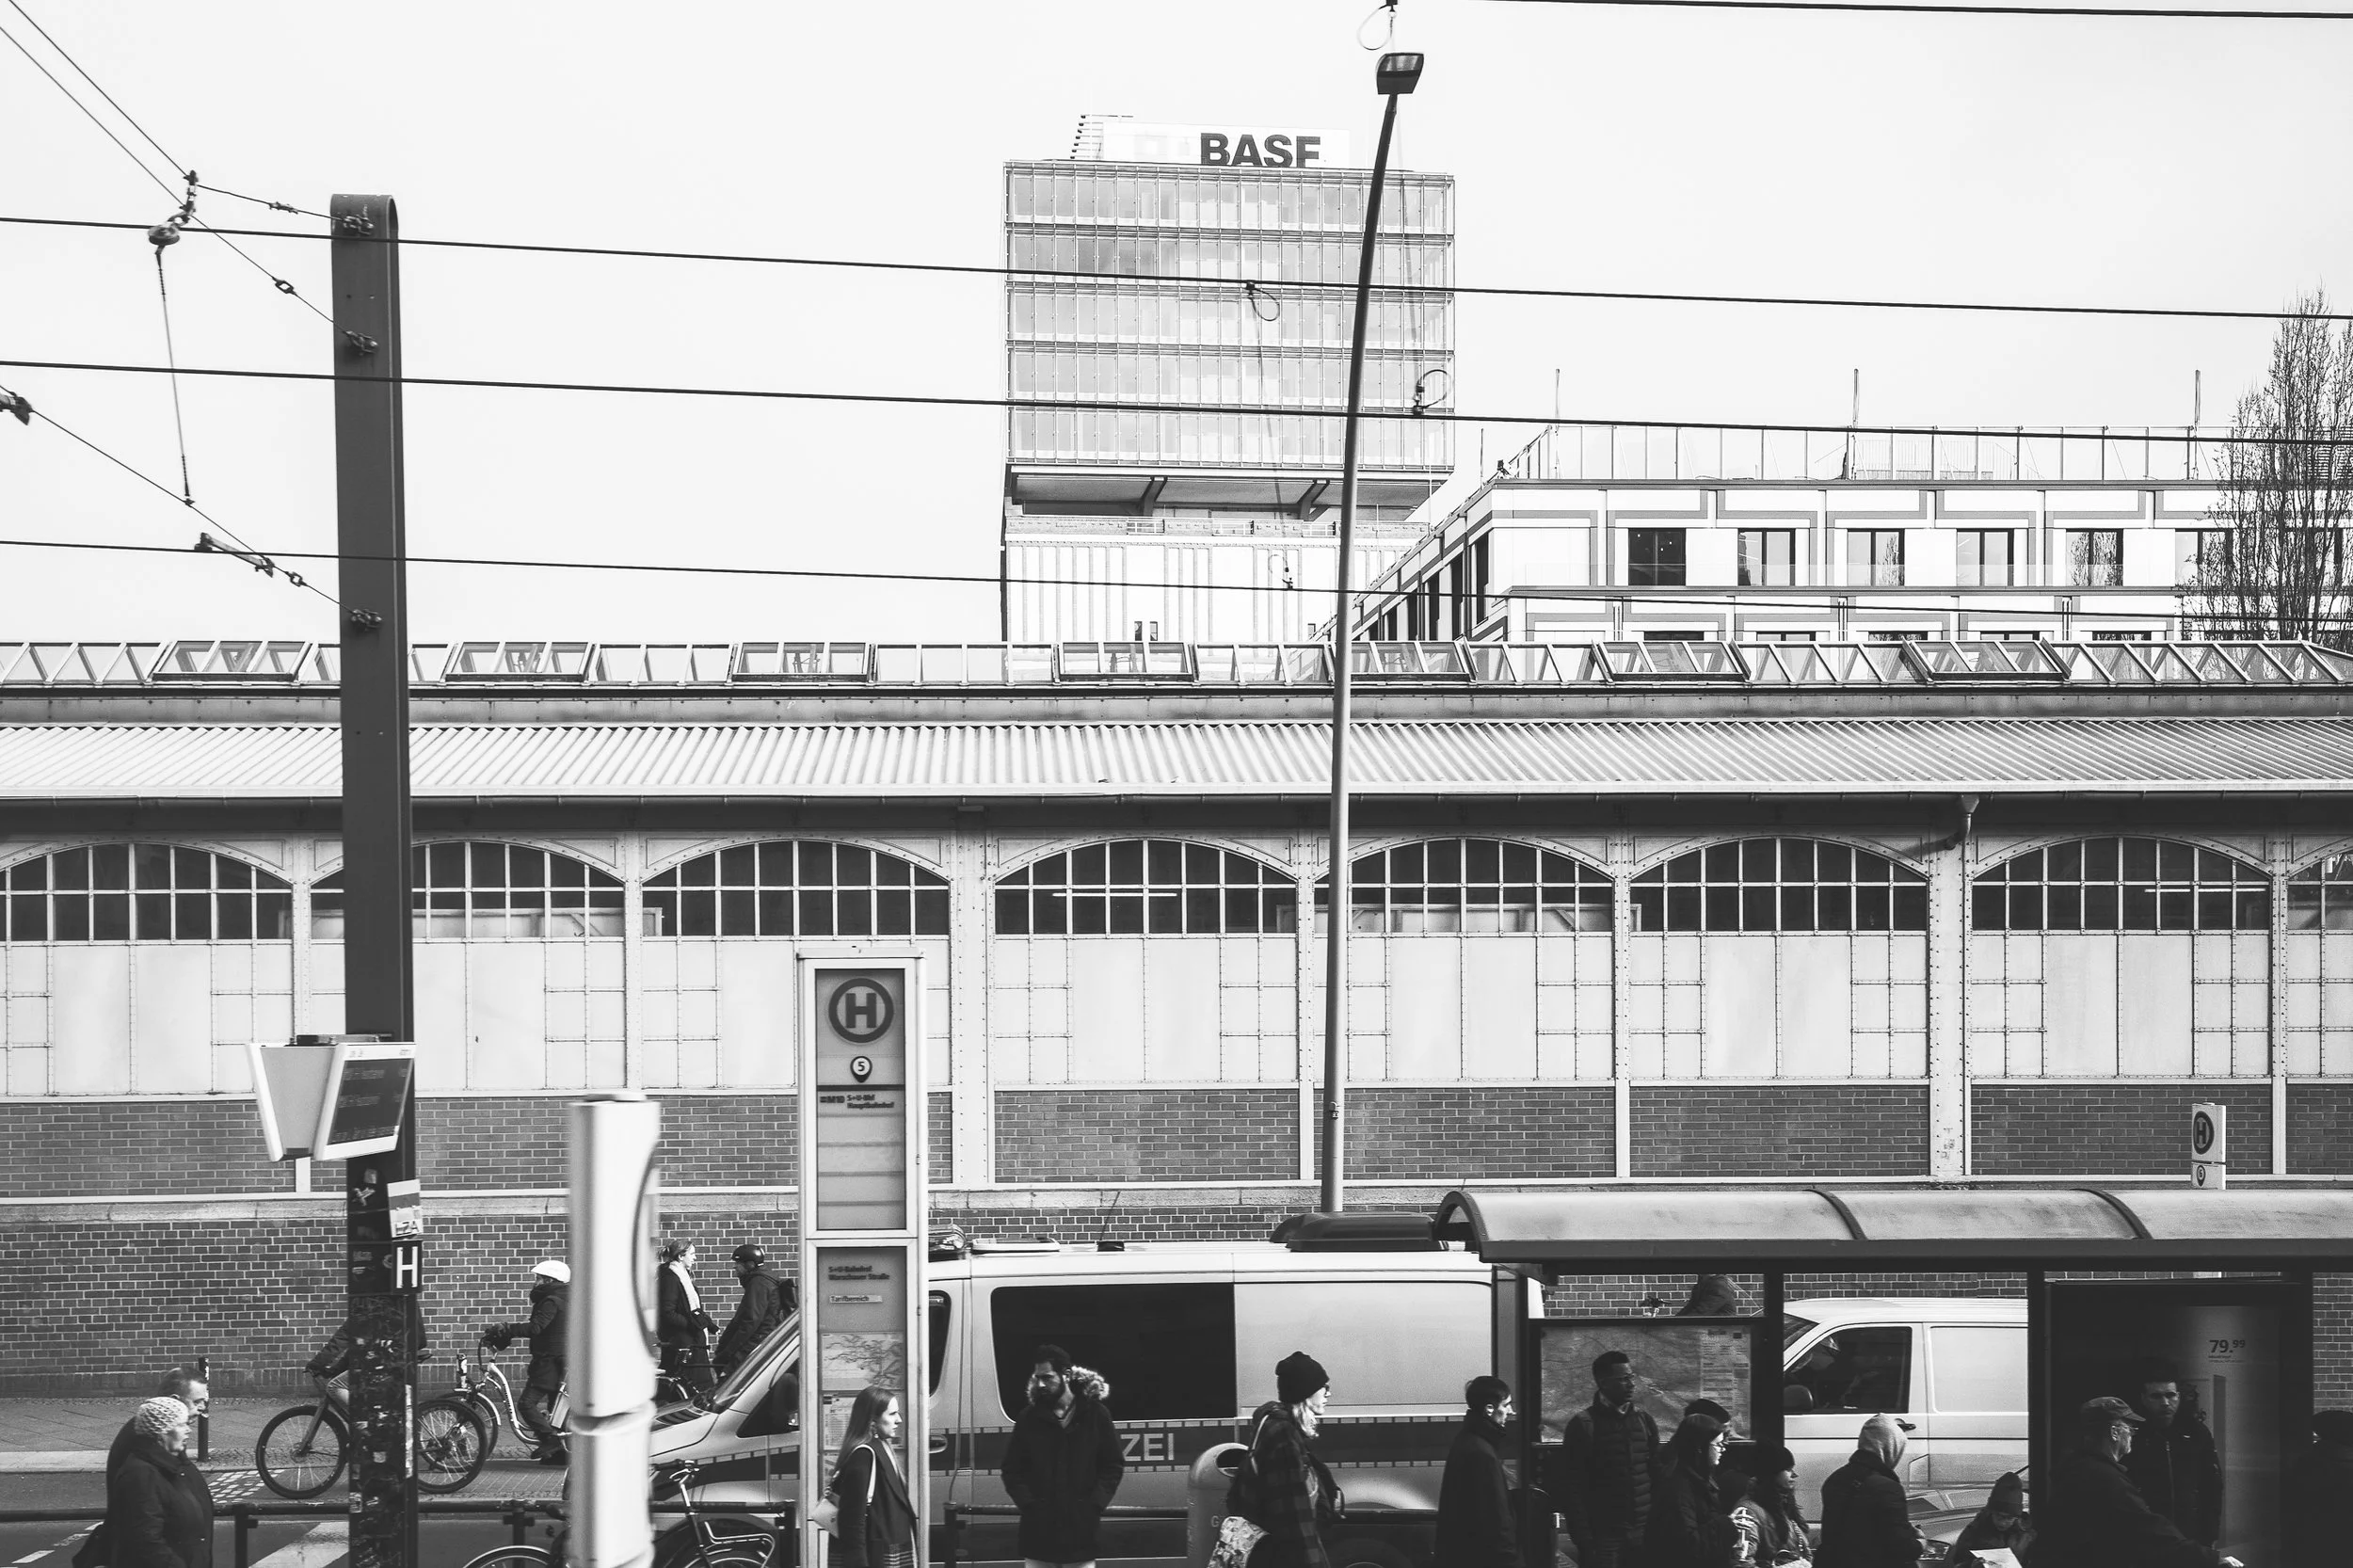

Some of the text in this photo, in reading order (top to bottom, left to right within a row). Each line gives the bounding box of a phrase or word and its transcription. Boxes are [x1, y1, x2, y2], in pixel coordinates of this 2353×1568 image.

[1201, 133, 1321, 168] BASF
[845, 993, 877, 1029] H
[857, 1061, 865, 1072] 5
[2197, 1121, 2206, 1144] H
[395, 1246, 419, 1288] H
[2209, 1339, 2246, 1353] 79.99
